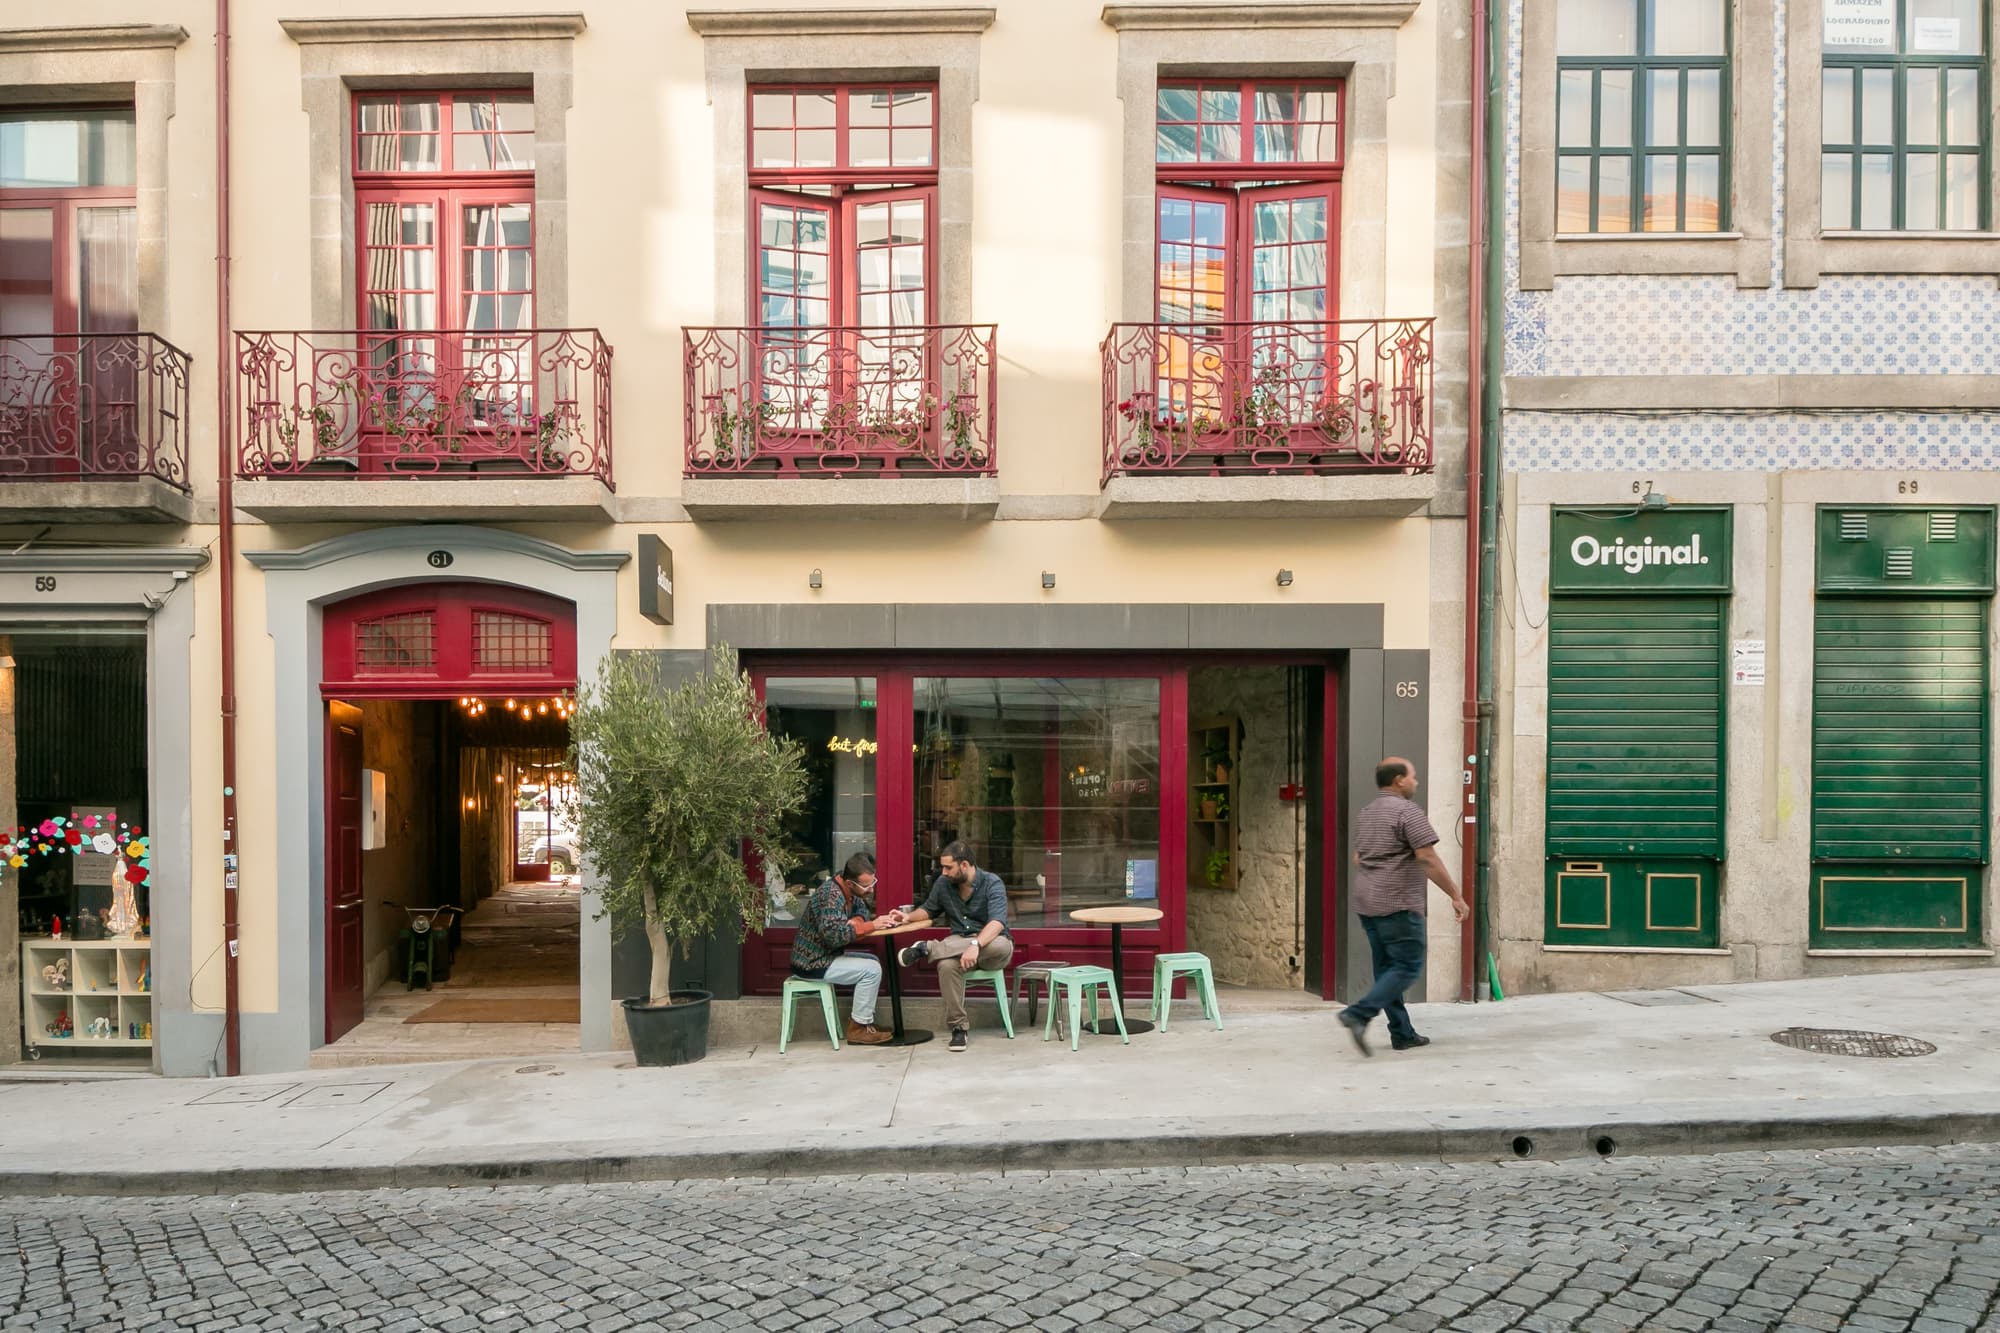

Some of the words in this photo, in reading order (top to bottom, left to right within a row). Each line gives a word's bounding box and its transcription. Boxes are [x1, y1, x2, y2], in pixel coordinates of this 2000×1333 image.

[1826, 17, 1890, 25] LOGRADOURO
[1632, 480, 1653, 495] 67
[1898, 480, 1918, 494] 69
[431, 553, 447, 566] 61
[1570, 533, 1709, 574] Original.
[35, 576, 56, 592] 59
[1396, 681, 1418, 698] 65
[827, 735, 851, 752] but
